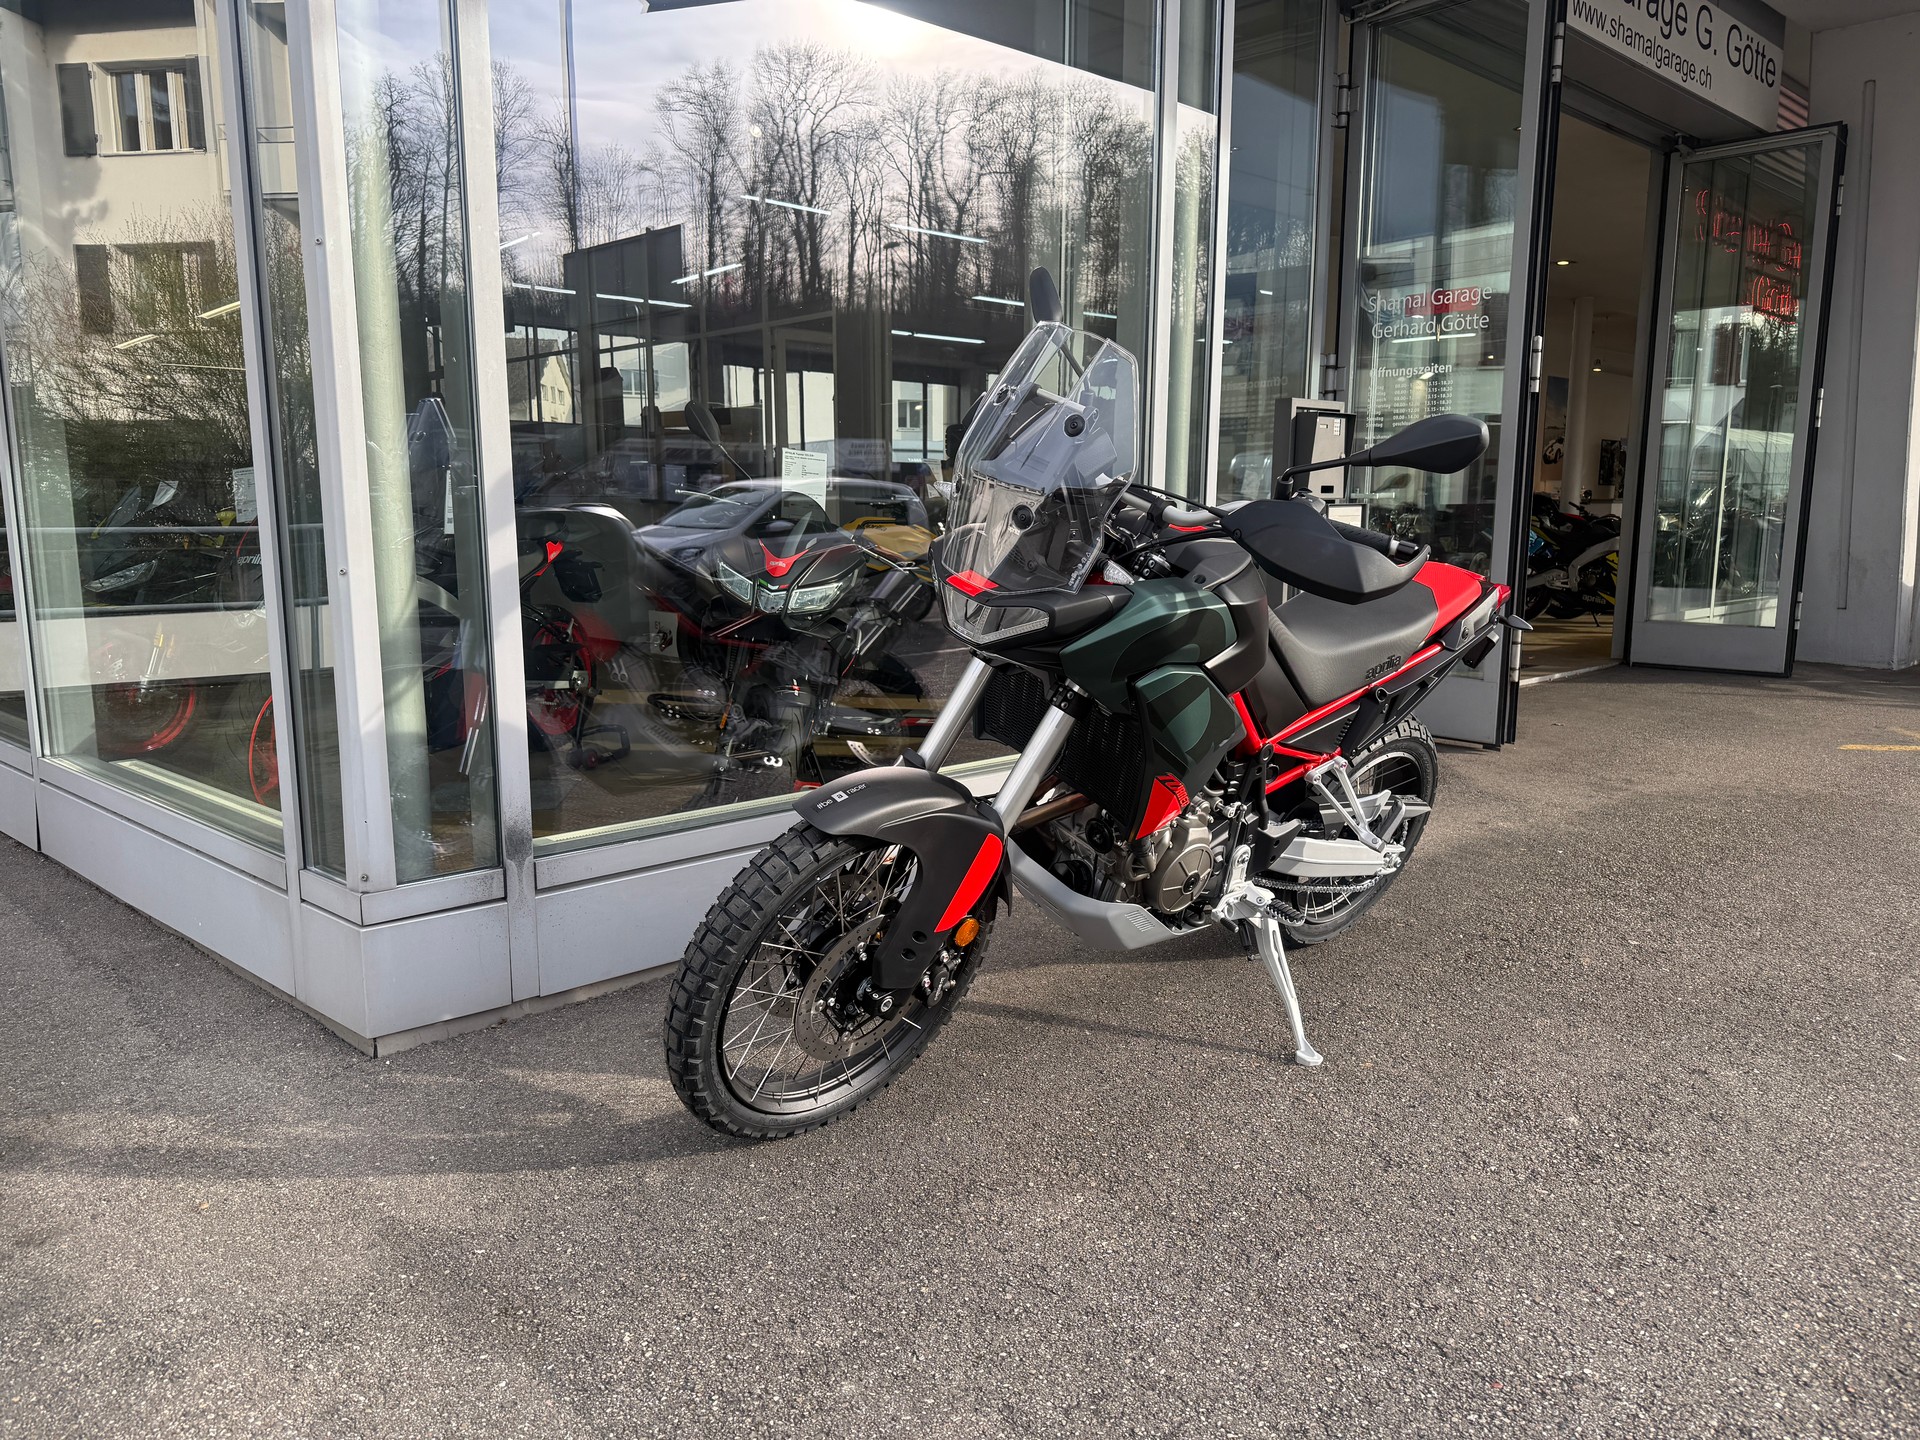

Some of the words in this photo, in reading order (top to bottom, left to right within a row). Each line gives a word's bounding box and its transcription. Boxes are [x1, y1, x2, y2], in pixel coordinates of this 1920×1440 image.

[1572, 0, 1712, 90] www.shamalgarage.ch
[1622, 0, 1688, 39] age
[1696, 5, 1717, 56] G.
[1727, 24, 1776, 88] Götte
[1369, 286, 1426, 313] Shamal
[1431, 286, 1493, 306] Garage
[1372, 316, 1436, 339] Gerhard
[1441, 314, 1490, 332] Götte
[237, 553, 262, 566] aprili
[1365, 654, 1402, 680] aprilia
